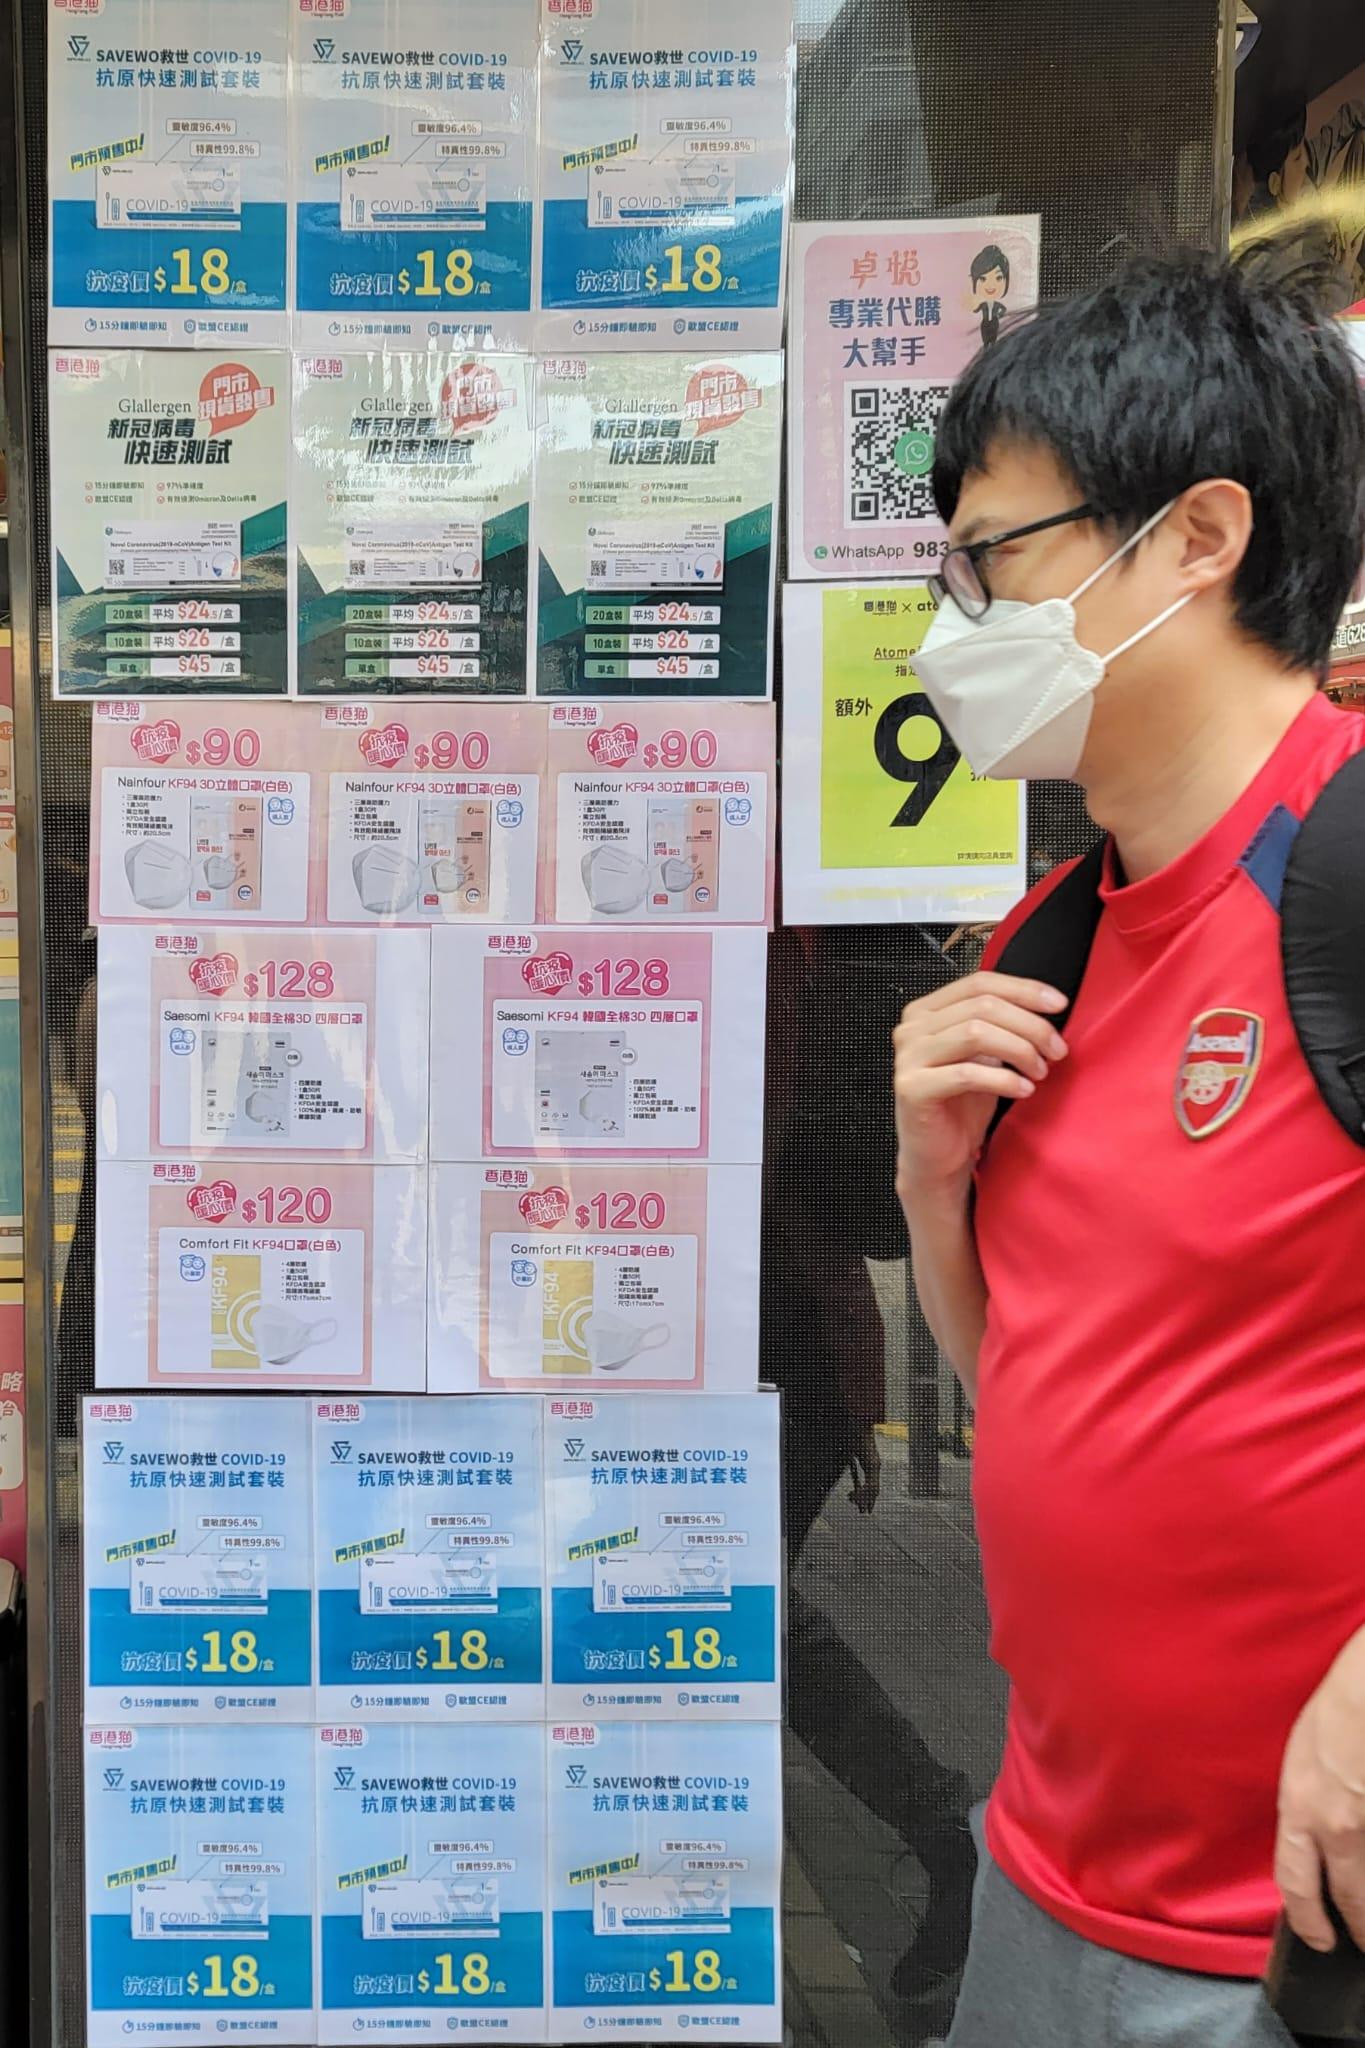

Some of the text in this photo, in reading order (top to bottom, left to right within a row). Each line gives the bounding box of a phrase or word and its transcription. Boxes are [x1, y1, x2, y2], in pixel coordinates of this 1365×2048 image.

[96, 49, 262, 64] SAVEWO救世 COVID-19
[342, 51, 507, 66] SAVEWO救世 COVID-19
[590, 50, 757, 66] SAVEWO救世 COVID-19
[96, 69, 260, 88] 抗原快速測試套裝
[342, 71, 506, 90] 抗原快速測試套裝
[589, 70, 756, 89] 抗原快速測試套裝
[126, 199, 188, 212] COVID-19
[87, 270, 149, 291] 抗疫價
[330, 273, 393, 295] 抗疫價
[576, 269, 640, 291] 抗疫價
[828, 296, 941, 328] 專業代購
[843, 337, 925, 367] 大幫手
[213, 374, 249, 397] 門市
[119, 399, 191, 417] Glallergen
[361, 398, 432, 416] Glallergen
[605, 400, 677, 416] Glallergen
[107, 419, 195, 439] 新冠病毒
[351, 417, 437, 437] 新冠病毒
[593, 419, 682, 439] 新冠病毒
[124, 439, 232, 464] 快速測試
[367, 439, 474, 464] 快速測試
[609, 439, 719, 464] 快速測試
[833, 546, 904, 560] WhatsApp
[113, 609, 142, 619] 20盒裝
[153, 609, 173, 619] 平均
[353, 609, 383, 619] 20盒裝
[393, 609, 413, 620] 平均
[593, 610, 623, 620] 20盒裝
[633, 611, 654, 621] 平均
[114, 636, 142, 647] 10盒裝
[153, 636, 174, 647] 平均
[179, 630, 209, 648] $26
[354, 630, 449, 648] 10盒裝 平均 $26
[593, 638, 621, 649] 10盒裝
[632, 638, 653, 649] 平均
[658, 631, 688, 649] $26
[874, 646, 921, 658] Atome
[179, 656, 210, 673] $45
[418, 657, 449, 673] $45
[657, 658, 688, 674] $45
[186, 728, 260, 766] $90
[414, 731, 489, 769] $90
[644, 730, 717, 767] $90
[836, 692, 961, 827] 額外 9
[118, 777, 166, 788] Nainfour
[168, 779, 197, 789] KF94
[346, 782, 393, 793] Nainfour
[397, 783, 424, 793] KF94
[574, 782, 622, 793] Nainfour
[626, 783, 654, 793] KF94
[244, 961, 334, 997] $128
[579, 959, 669, 997] $128
[164, 1011, 210, 1021] Saesomi
[215, 1012, 244, 1022] KF94
[497, 1011, 543, 1021] Saesomi
[548, 1012, 578, 1021] KF94
[243, 1187, 332, 1223] $120
[575, 1193, 665, 1229] $120
[179, 1239, 229, 1249] Comfort
[234, 1239, 248, 1249] Fit
[511, 1245, 561, 1255] Comfort
[566, 1245, 581, 1255] Fit
[130, 1452, 285, 1466] SAVEWO救世 COVID-19
[358, 1451, 513, 1465] SAVEWO救世 COVID-19
[591, 1450, 747, 1463] SAVEWO救世 COVID-19
[130, 1471, 285, 1488] 抗原快速測試套裝
[358, 1469, 513, 1487] 抗原快速測試套裝
[591, 1468, 747, 1484] 抗原快速測試套裝
[389, 1586, 448, 1598] COVID-19
[121, 1651, 182, 1671] 抗疫價
[352, 1651, 412, 1671] 抗疫價
[584, 1650, 644, 1669] 抗疫價
[130, 1778, 285, 1791] SAVEWO救世 COVID-19
[361, 1777, 516, 1790] SAVEWO救世 COVID-19
[593, 1776, 749, 1789] SAVEWO救世 COVID-19
[130, 1796, 285, 1813] 抗原快速測試套裝
[361, 1796, 516, 1813] 抗原快速測試套裝
[593, 1795, 748, 1811] 抗原快速測試套裝
[123, 1976, 183, 1996] 抗疫價
[354, 1974, 413, 1994] 抗疫價
[585, 1972, 645, 1992] 抗疫價
